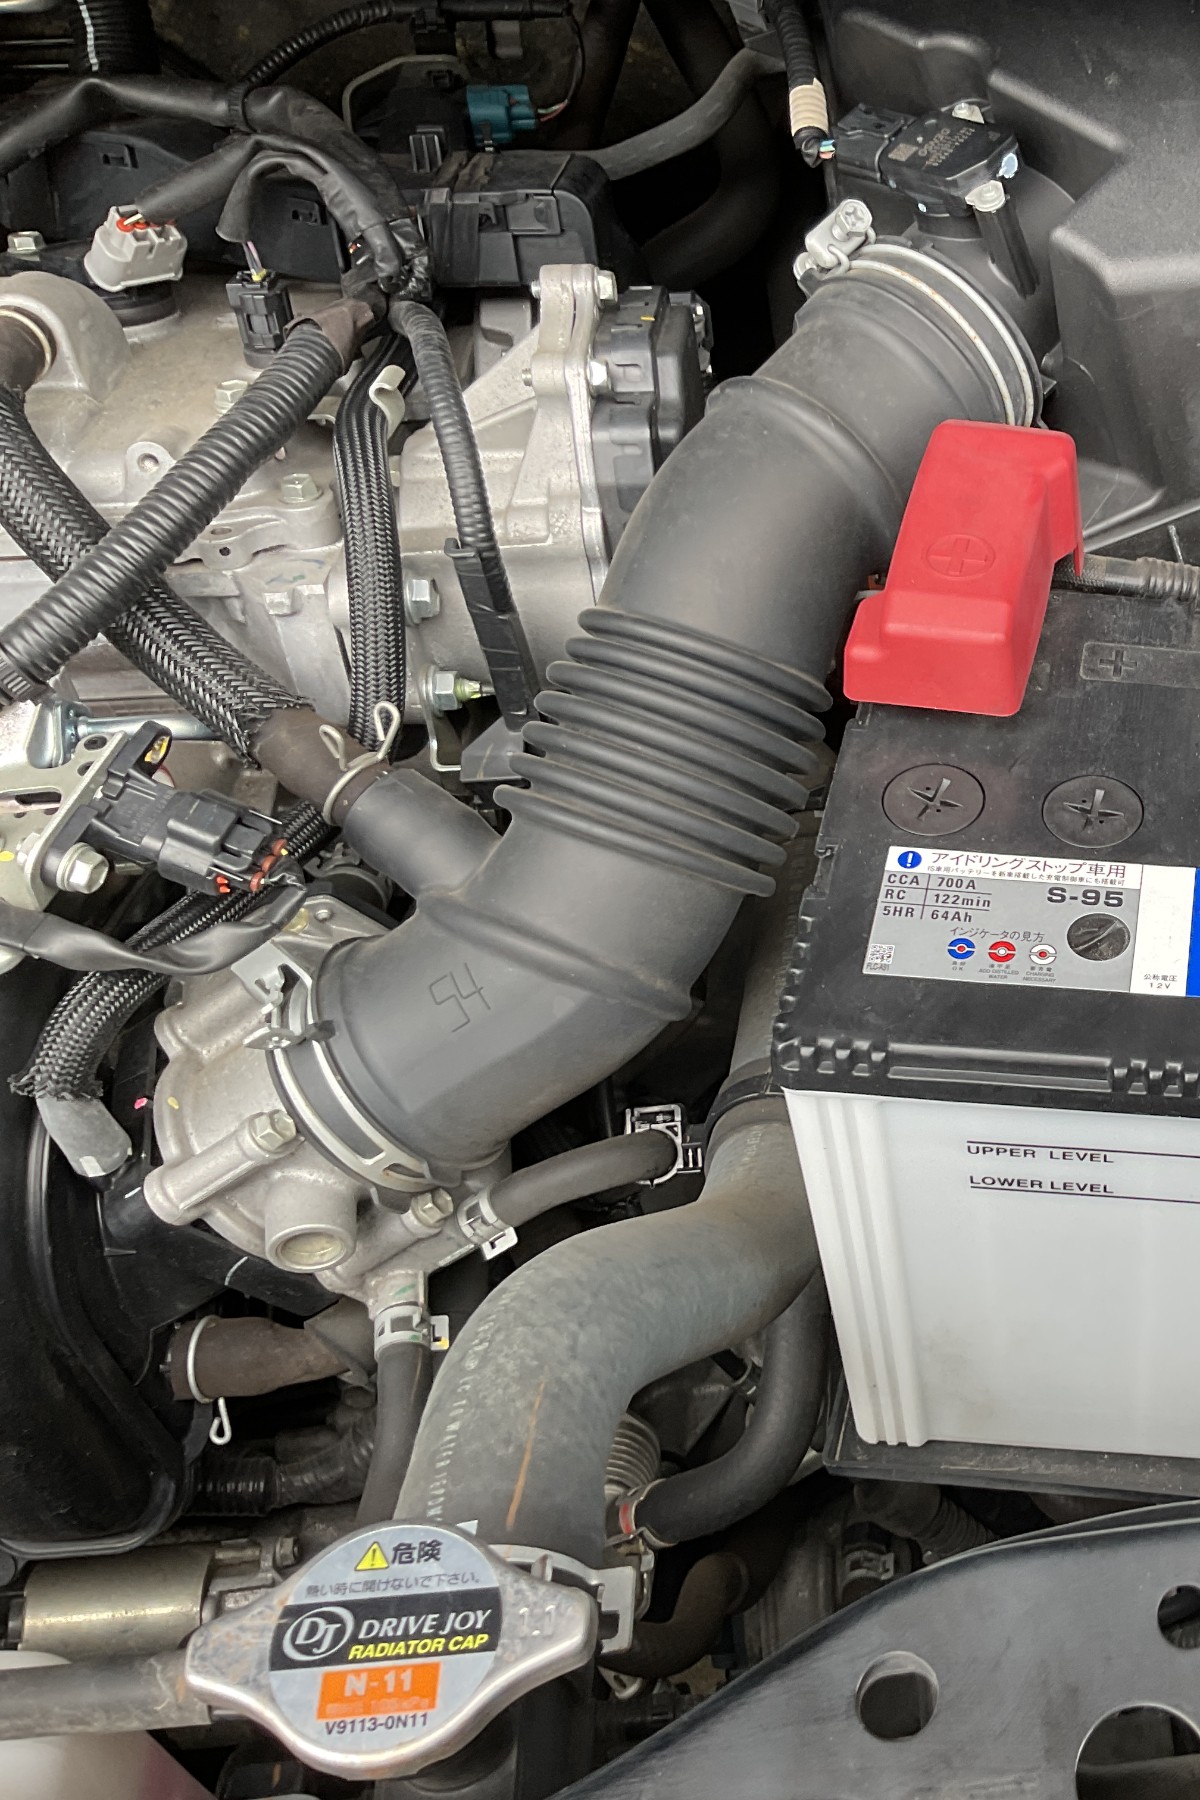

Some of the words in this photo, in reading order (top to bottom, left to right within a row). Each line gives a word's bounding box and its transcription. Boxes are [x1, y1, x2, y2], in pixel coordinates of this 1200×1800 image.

[931, 852, 1126, 879] アイドリングストップ車用
[887, 874, 920, 886] CCA
[937, 877, 976, 890] 700A
[884, 889, 907, 900] RC
[934, 893, 991, 908] 122min
[1047, 887, 1124, 908] S-95
[882, 905, 915, 918] 5HR
[931, 909, 973, 923] 64Ah
[950, 926, 1045, 943] インジケータの見方
[967, 1146, 1036, 1158] UPPER
[1050, 1151, 1114, 1163] LEVEL
[969, 1175, 1043, 1189] LOWER
[1050, 1181, 1114, 1194] LEVEL
[392, 1539, 443, 1565] 危険
[358, 1613, 439, 1639] DRIVE
[440, 1609, 492, 1636] JOY
[348, 1640, 443, 1660] RADIATOR
[446, 1634, 489, 1651] CAP
[344, 1668, 413, 1697] N-11
[325, 1712, 428, 1735] V9113-0N11
